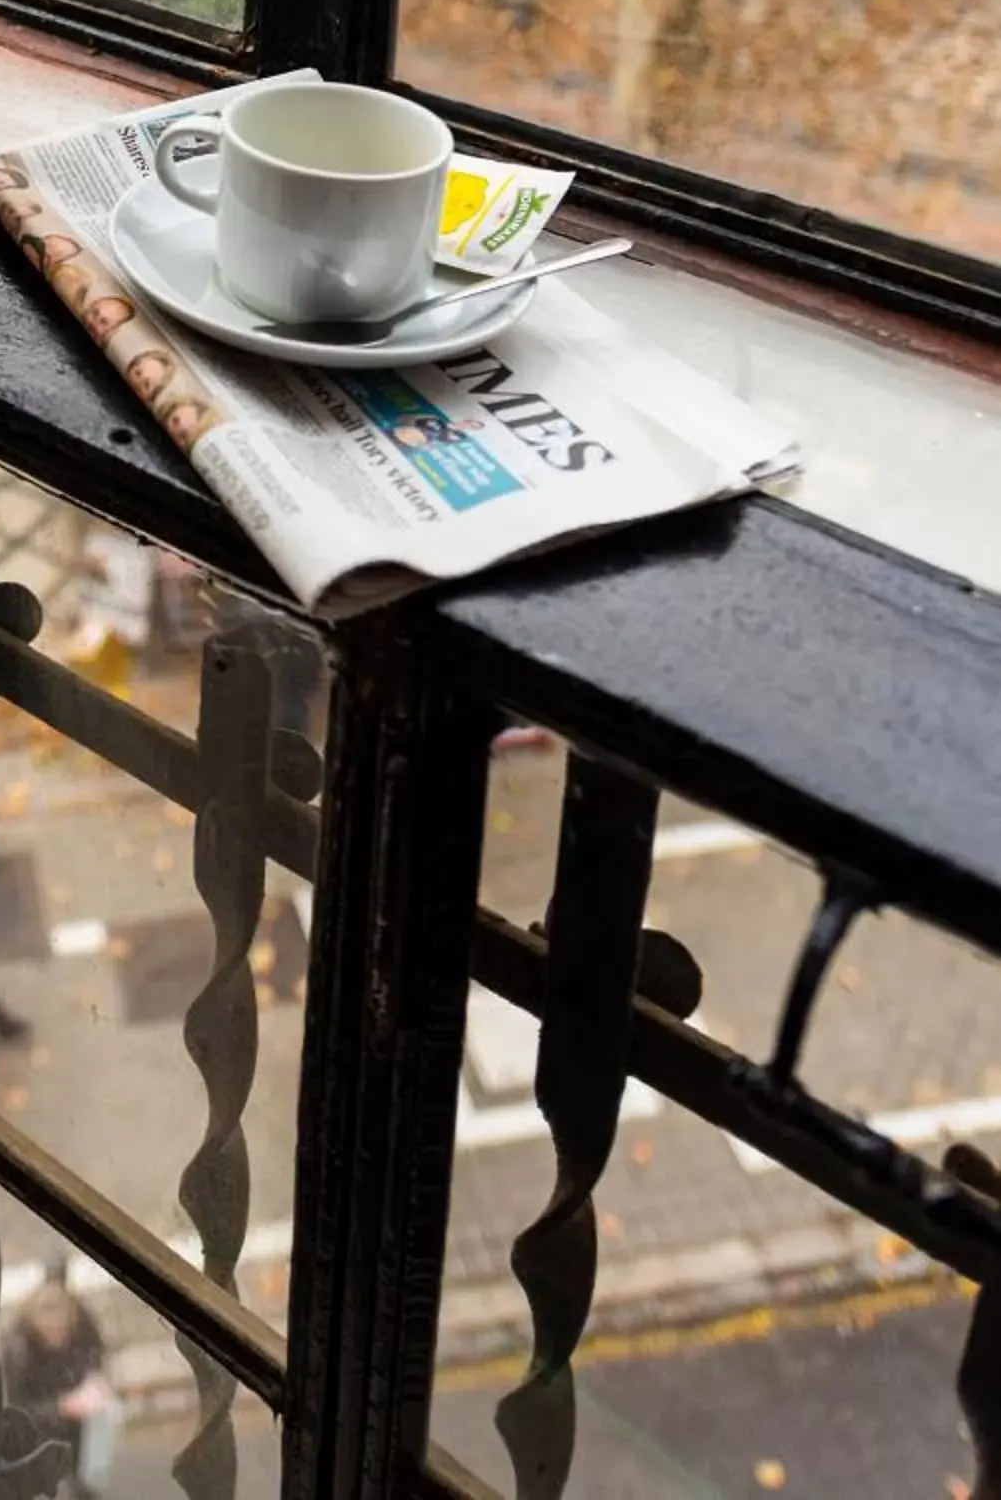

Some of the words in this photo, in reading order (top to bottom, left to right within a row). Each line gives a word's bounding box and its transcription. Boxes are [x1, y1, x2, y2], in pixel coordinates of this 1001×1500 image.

[116, 126, 150, 172] Shares
[327, 403, 365, 434] hail
[353, 430, 389, 466] Tory
[386, 466, 440, 523] victory
[432, 346, 615, 472] IMES
